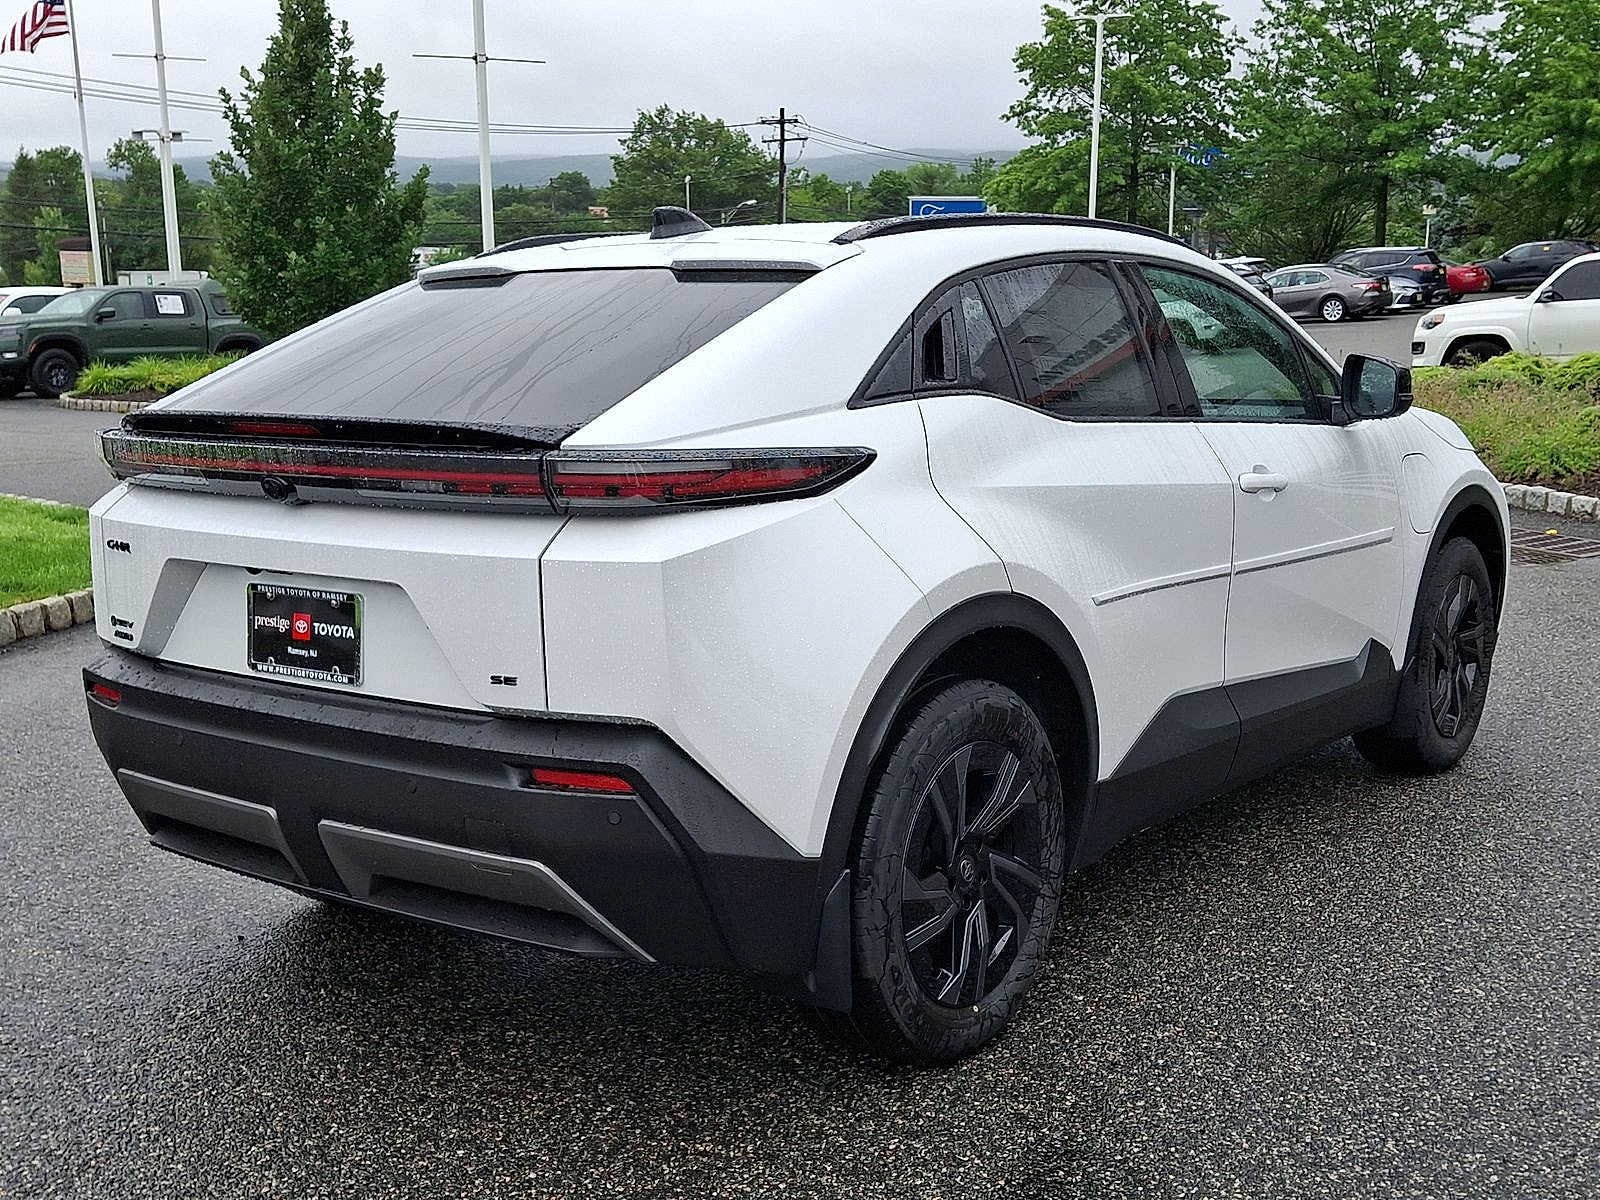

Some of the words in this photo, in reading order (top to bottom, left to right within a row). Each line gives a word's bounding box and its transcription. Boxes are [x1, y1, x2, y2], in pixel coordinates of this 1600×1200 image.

[257, 585, 285, 594] PRESTIGE
[286, 589, 310, 597] TOYOTA
[322, 592, 347, 602] RAMSEY
[254, 615, 290, 633] prestige
[313, 622, 355, 639] TOYOTA
[310, 649, 318, 657] NJ
[490, 675, 518, 686] SE
